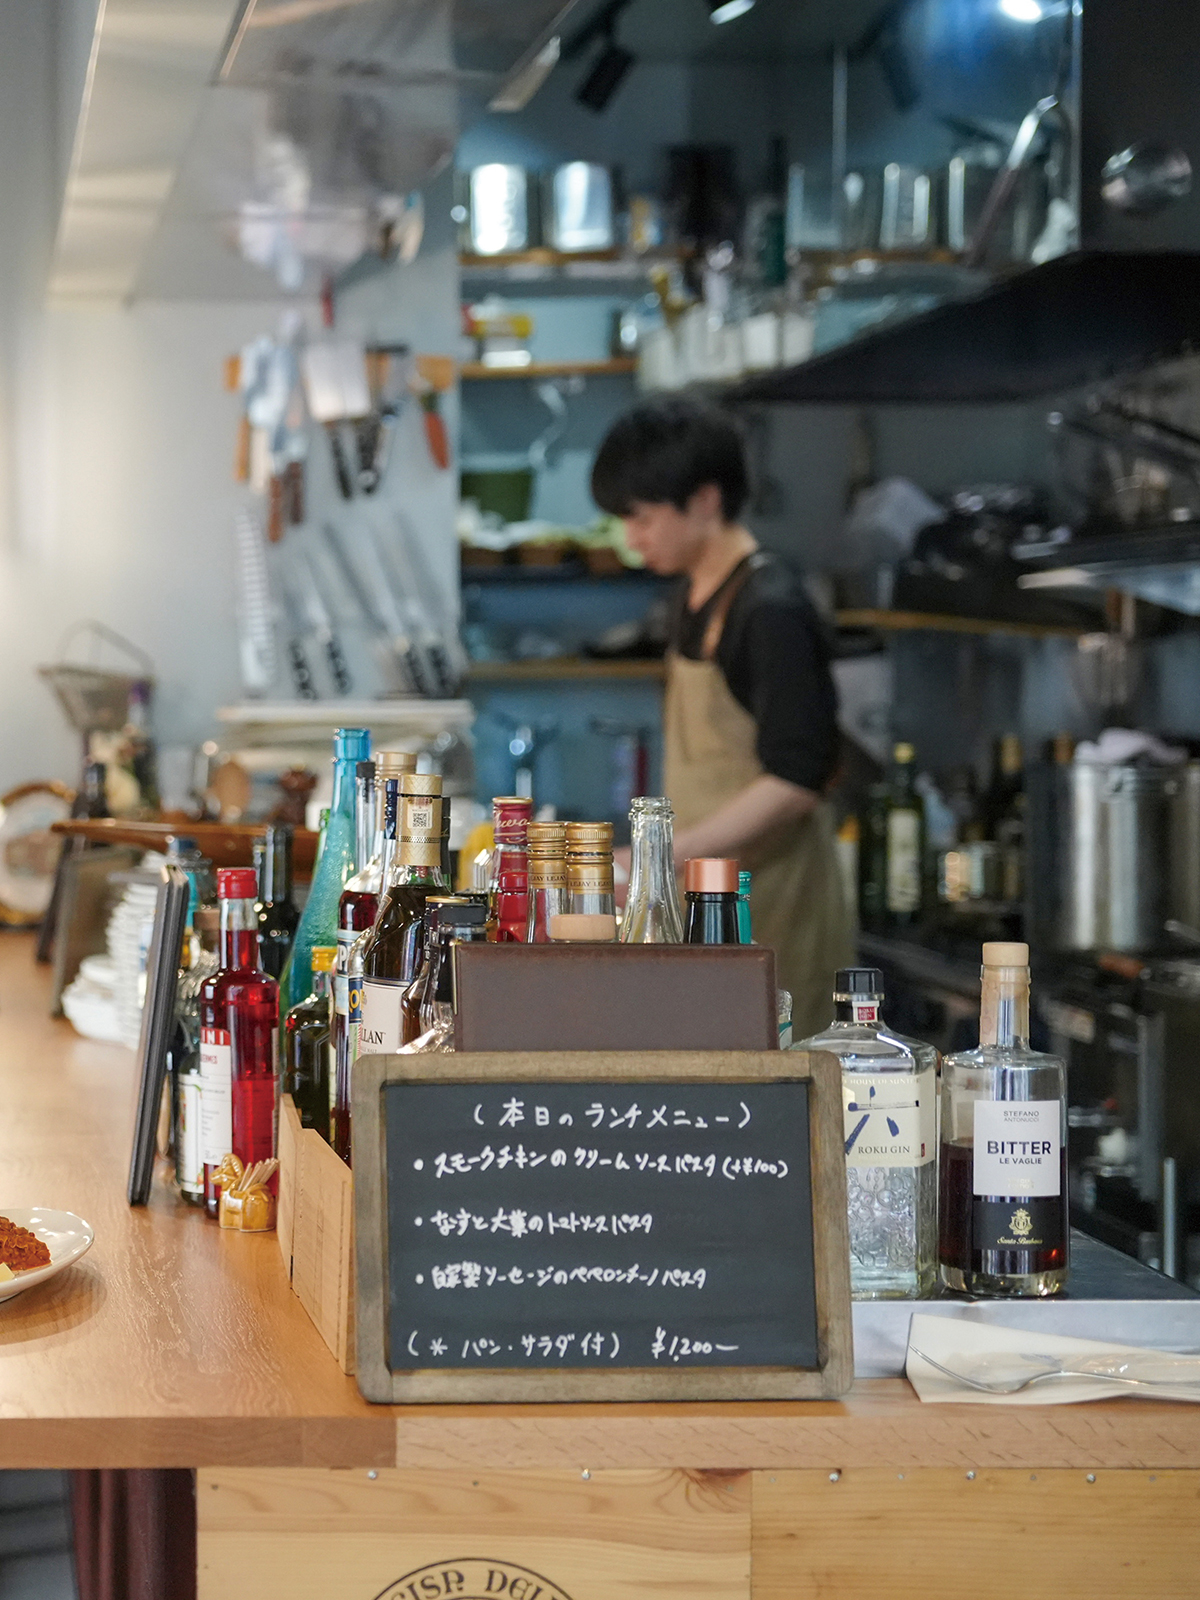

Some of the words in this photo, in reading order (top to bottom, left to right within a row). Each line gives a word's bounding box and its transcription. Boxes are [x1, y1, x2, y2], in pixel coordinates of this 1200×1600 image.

[361, 1028, 384, 1045] LAN
[858, 1145, 888, 1154] ROKU
[890, 1145, 911, 1154] GIN
[986, 1140, 1052, 1155] BITTER
[999, 1157, 1010, 1165] LE
[1012, 1157, 1043, 1165] VAGLIE
